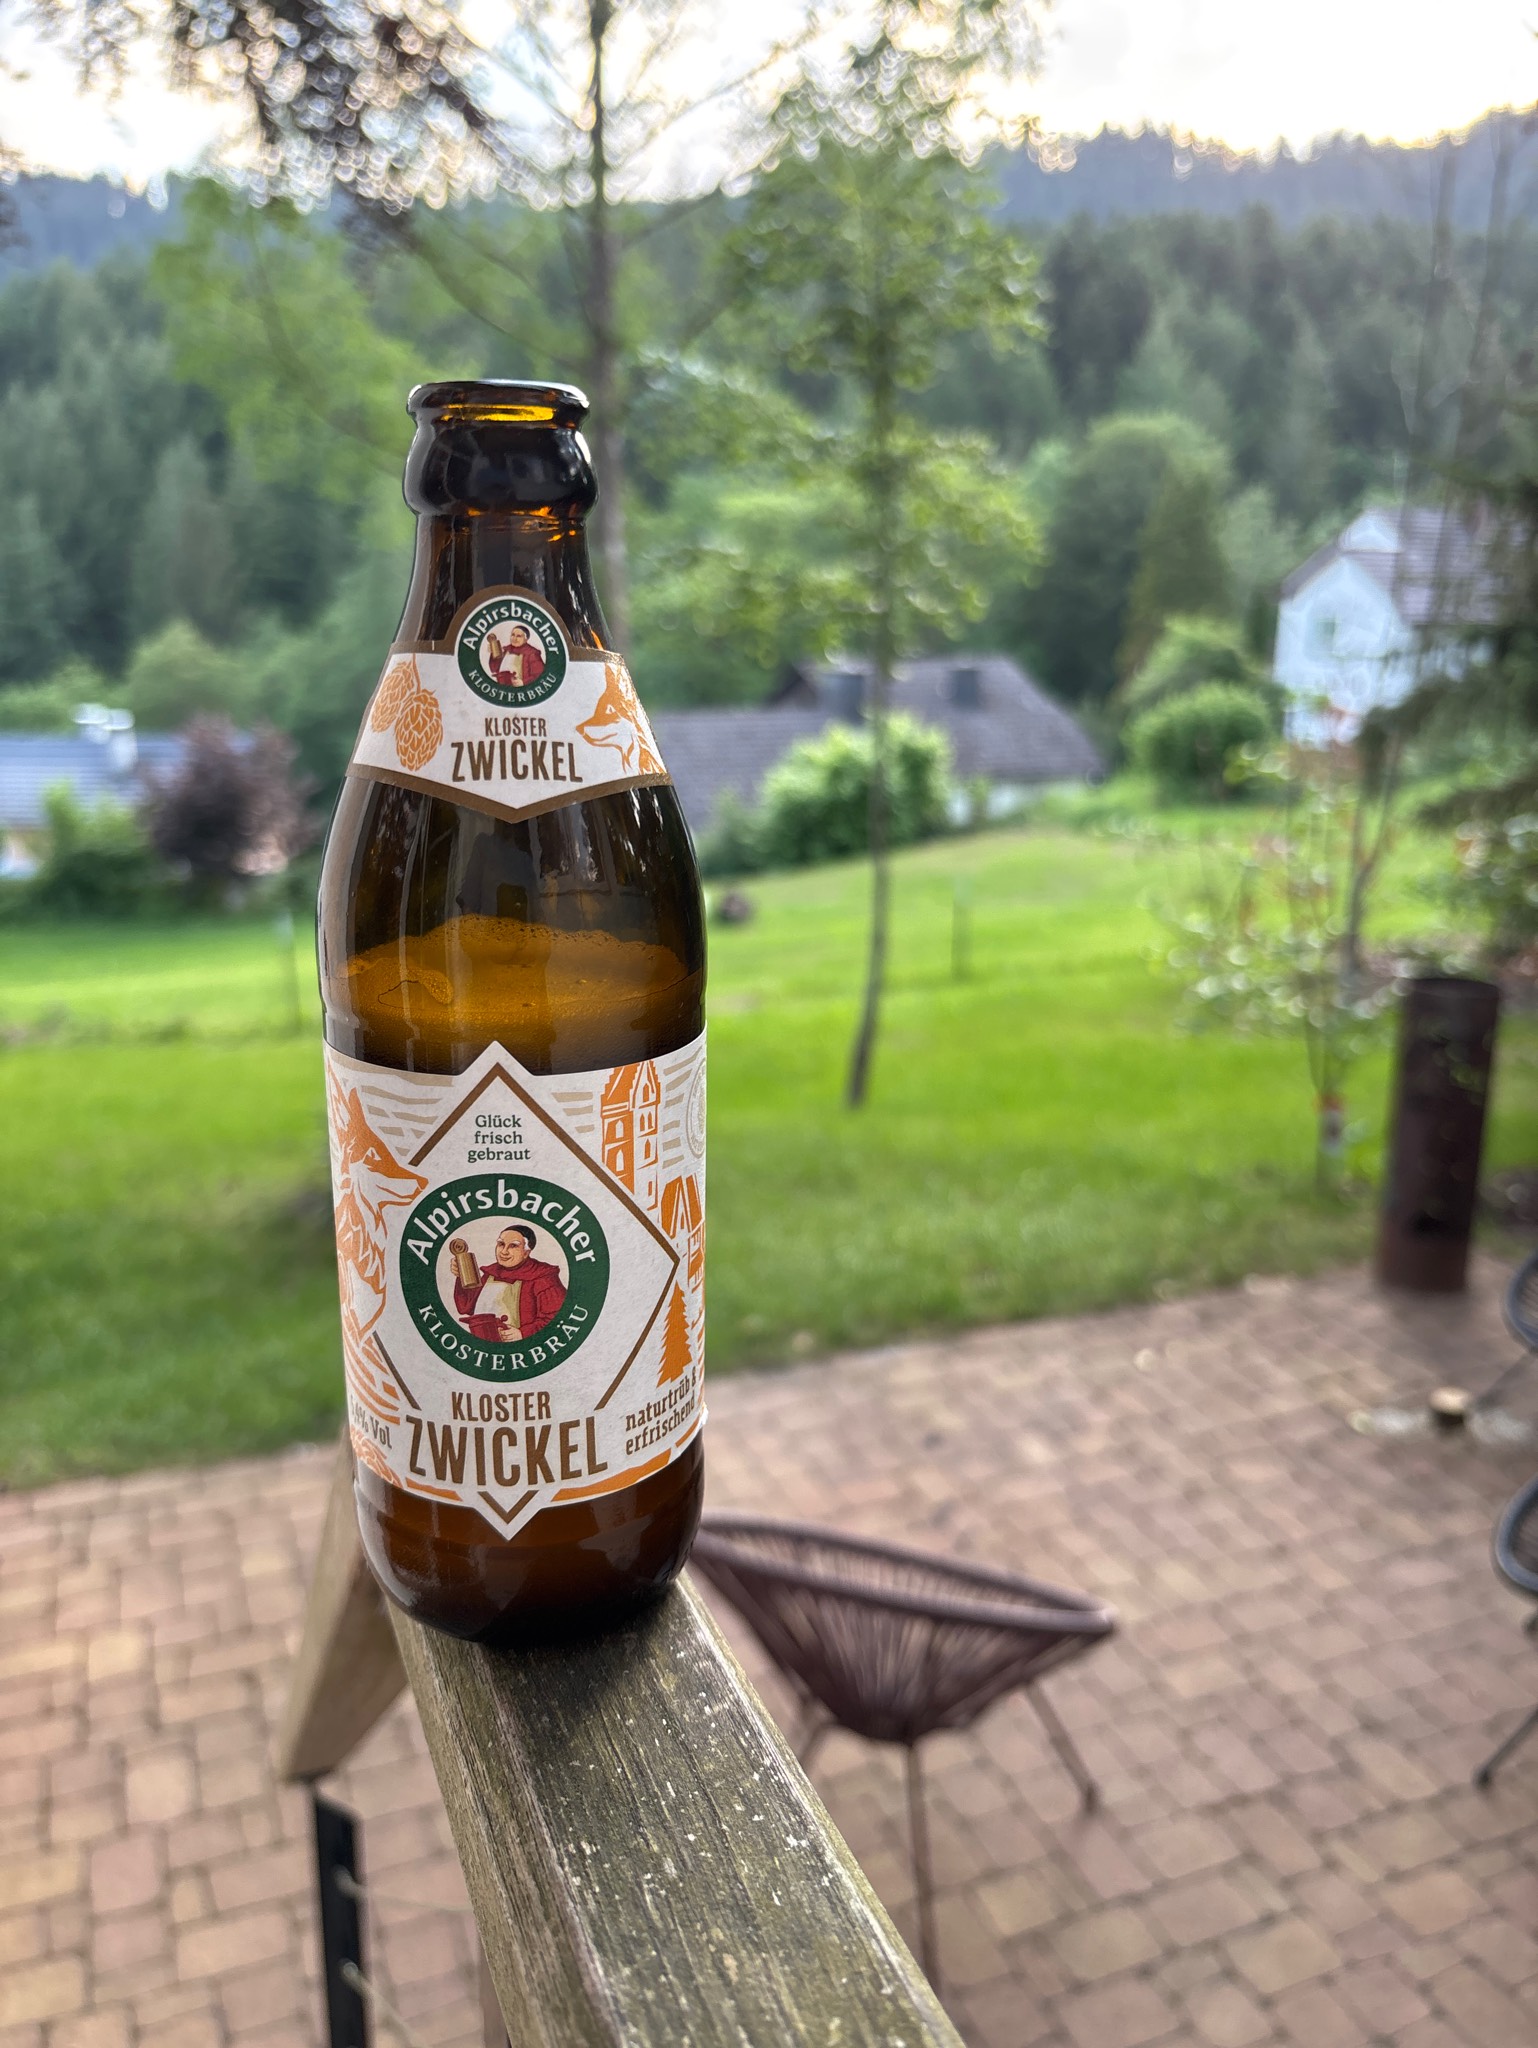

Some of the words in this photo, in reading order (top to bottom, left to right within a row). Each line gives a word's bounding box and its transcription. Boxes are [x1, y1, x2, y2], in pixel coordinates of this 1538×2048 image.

[462, 601, 560, 656] Alpirsbacher
[468, 669, 558, 703] KLOSTERBRÄU
[485, 717, 547, 738] KLOSTER
[450, 739, 584, 784] ZWICKEL
[474, 1130, 523, 1145] frisch
[475, 1114, 522, 1128] Glück
[467, 1147, 531, 1163] gebraut
[406, 1178, 597, 1266] Alpirsbacher
[418, 1303, 590, 1372] KLOSTERBRÄU
[451, 1391, 552, 1422] KLOSTER
[625, 1374, 690, 1432] naturtrüb
[691, 1365, 697, 1388] &
[369, 1415, 393, 1450] Vol
[625, 1390, 695, 1456] erfrischend
[405, 1415, 608, 1488] ZWICKEL
